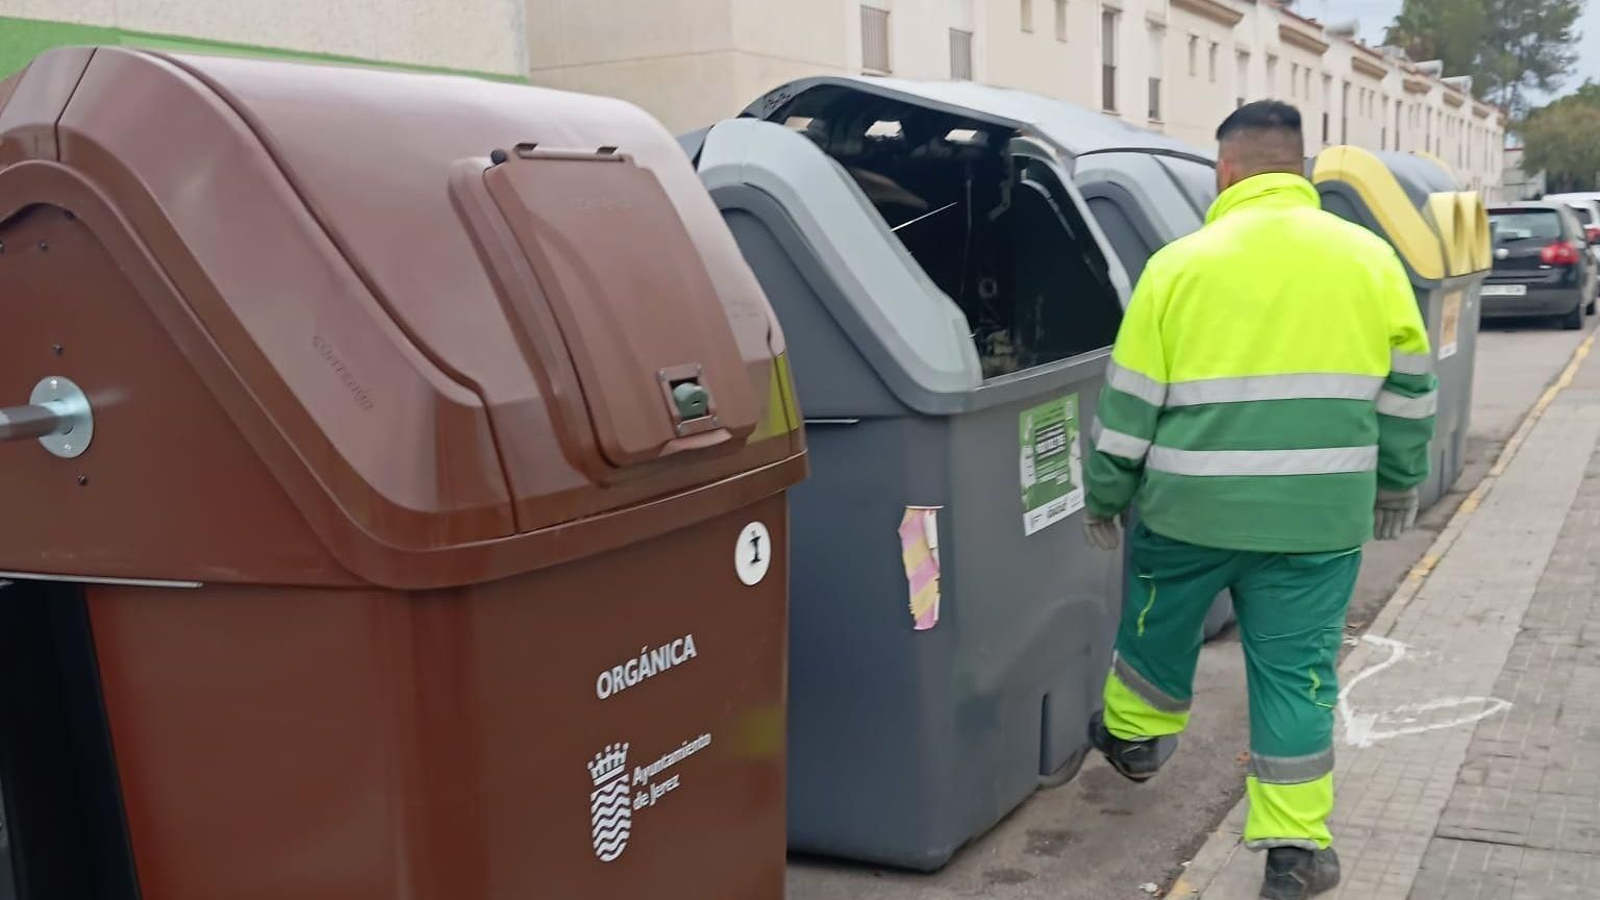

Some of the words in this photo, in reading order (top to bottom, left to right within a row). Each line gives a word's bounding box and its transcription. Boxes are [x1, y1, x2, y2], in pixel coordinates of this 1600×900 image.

[596, 633, 698, 700] ORGÁNICA
[632, 732, 711, 787] Ayuntamiento
[633, 792, 650, 811] de
[650, 773, 681, 806] Jerez
